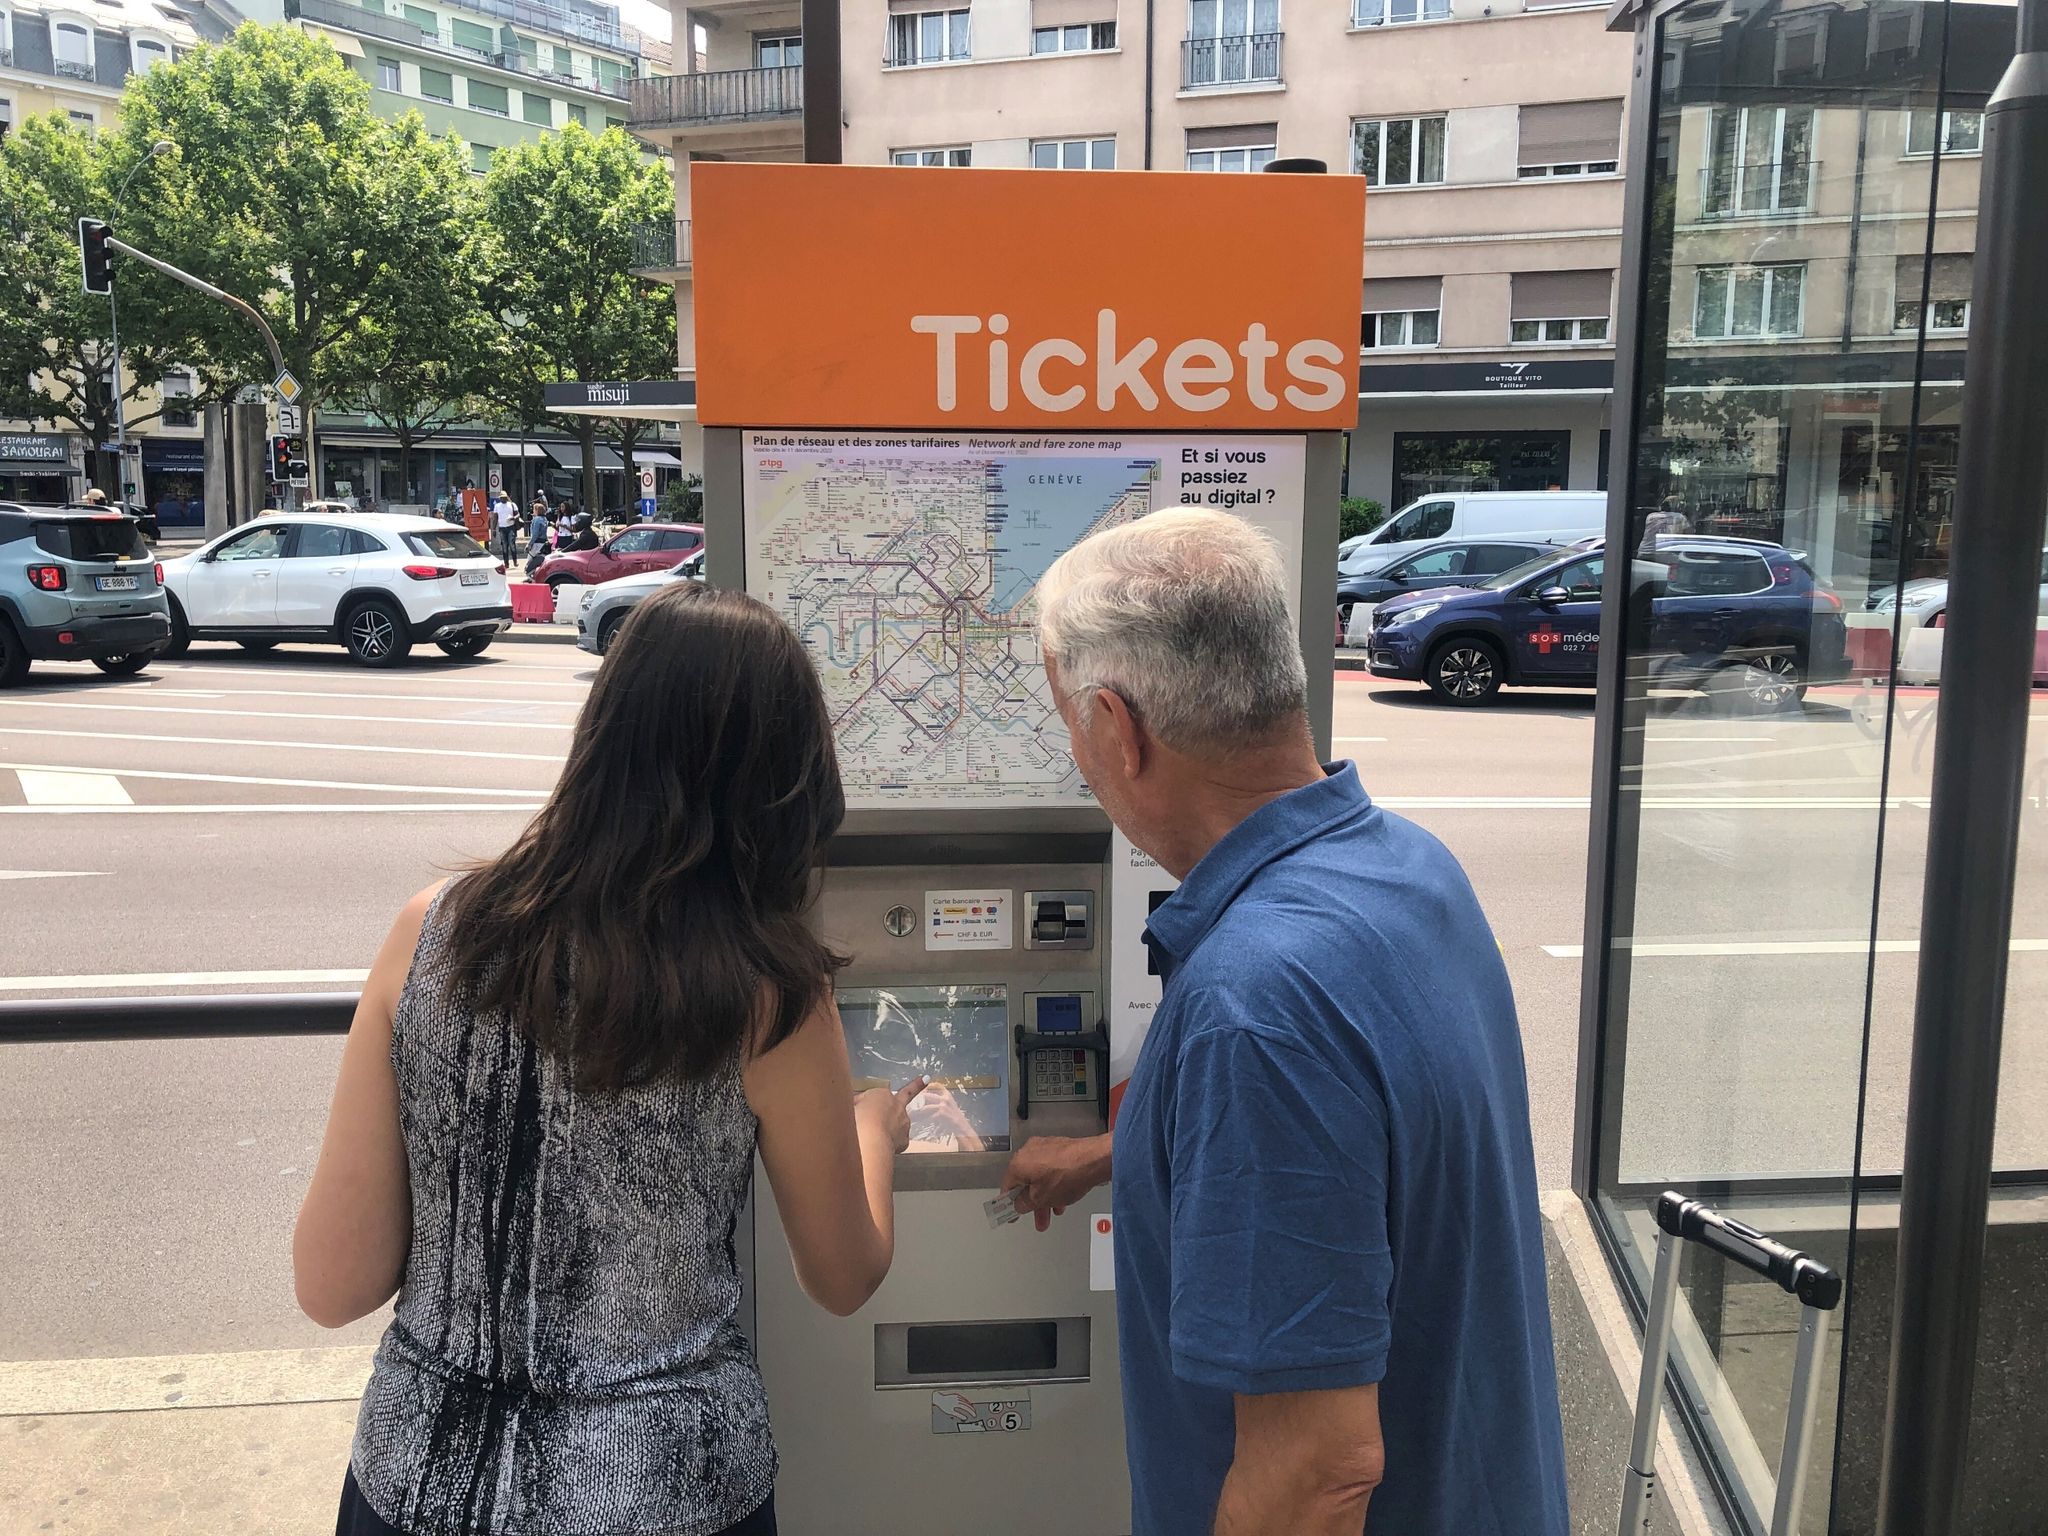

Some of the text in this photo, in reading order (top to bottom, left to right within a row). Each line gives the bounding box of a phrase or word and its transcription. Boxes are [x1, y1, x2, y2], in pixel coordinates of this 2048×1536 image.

[910, 308, 1346, 412] Tickets
[587, 384, 630, 405] misuji
[0, 437, 47, 445] ESTAURANT
[753, 436, 1122, 452] Plan de réseau et des zones tarifaires Network and fare zone map
[2, 446, 63, 457] SAMOURAI
[1182, 448, 1266, 463] Et si vous
[1181, 469, 1247, 488] passiez
[1180, 489, 1276, 508] au digital ?
[1532, 632, 1600, 642] SOS méde
[1128, 1001, 1152, 1009] Avec
[992, 1402, 1000, 1412] 2
[1005, 1414, 1017, 1430] 5
